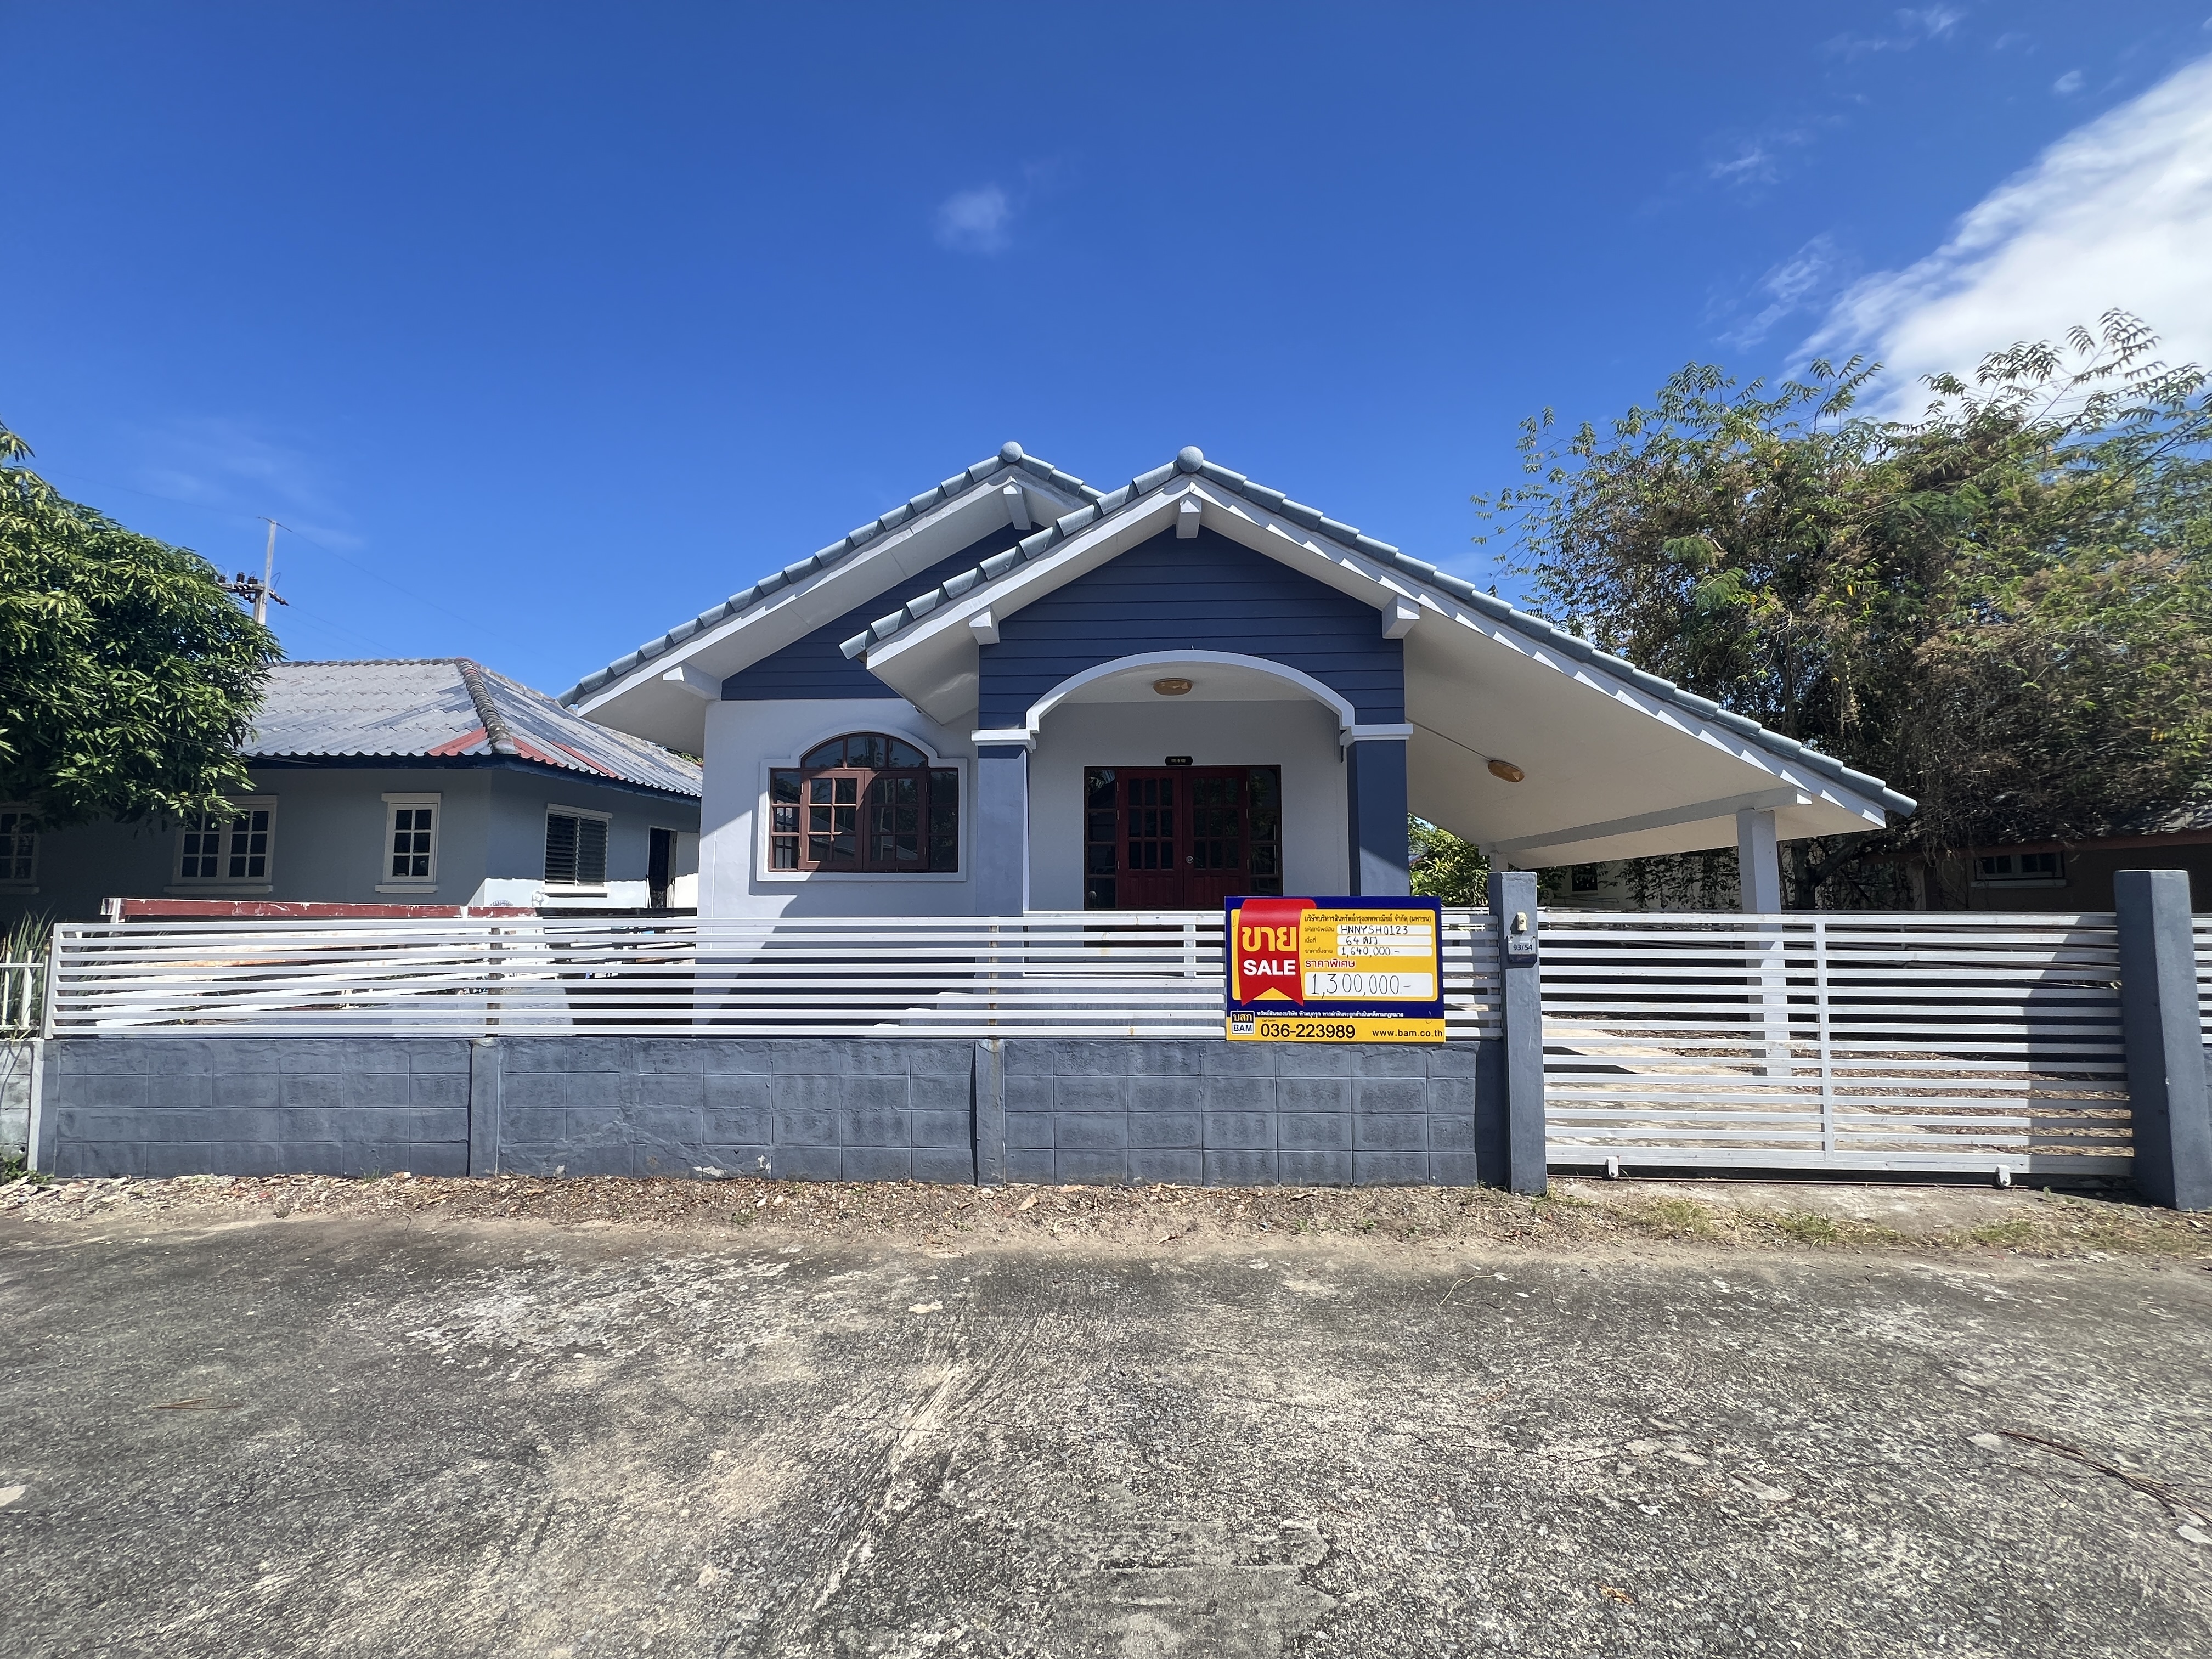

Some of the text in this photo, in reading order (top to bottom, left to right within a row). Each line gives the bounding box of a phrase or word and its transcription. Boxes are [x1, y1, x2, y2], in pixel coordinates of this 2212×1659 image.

[1242, 926, 1297, 952] ขาย
[1346, 936, 1359, 946] 64
[1243, 959, 1296, 976] SALE
[1305, 958, 1356, 968] ราคาพิเศษ
[1233, 1013, 1252, 1022] บสก
[1261, 1024, 1355, 1038] 036-223989
